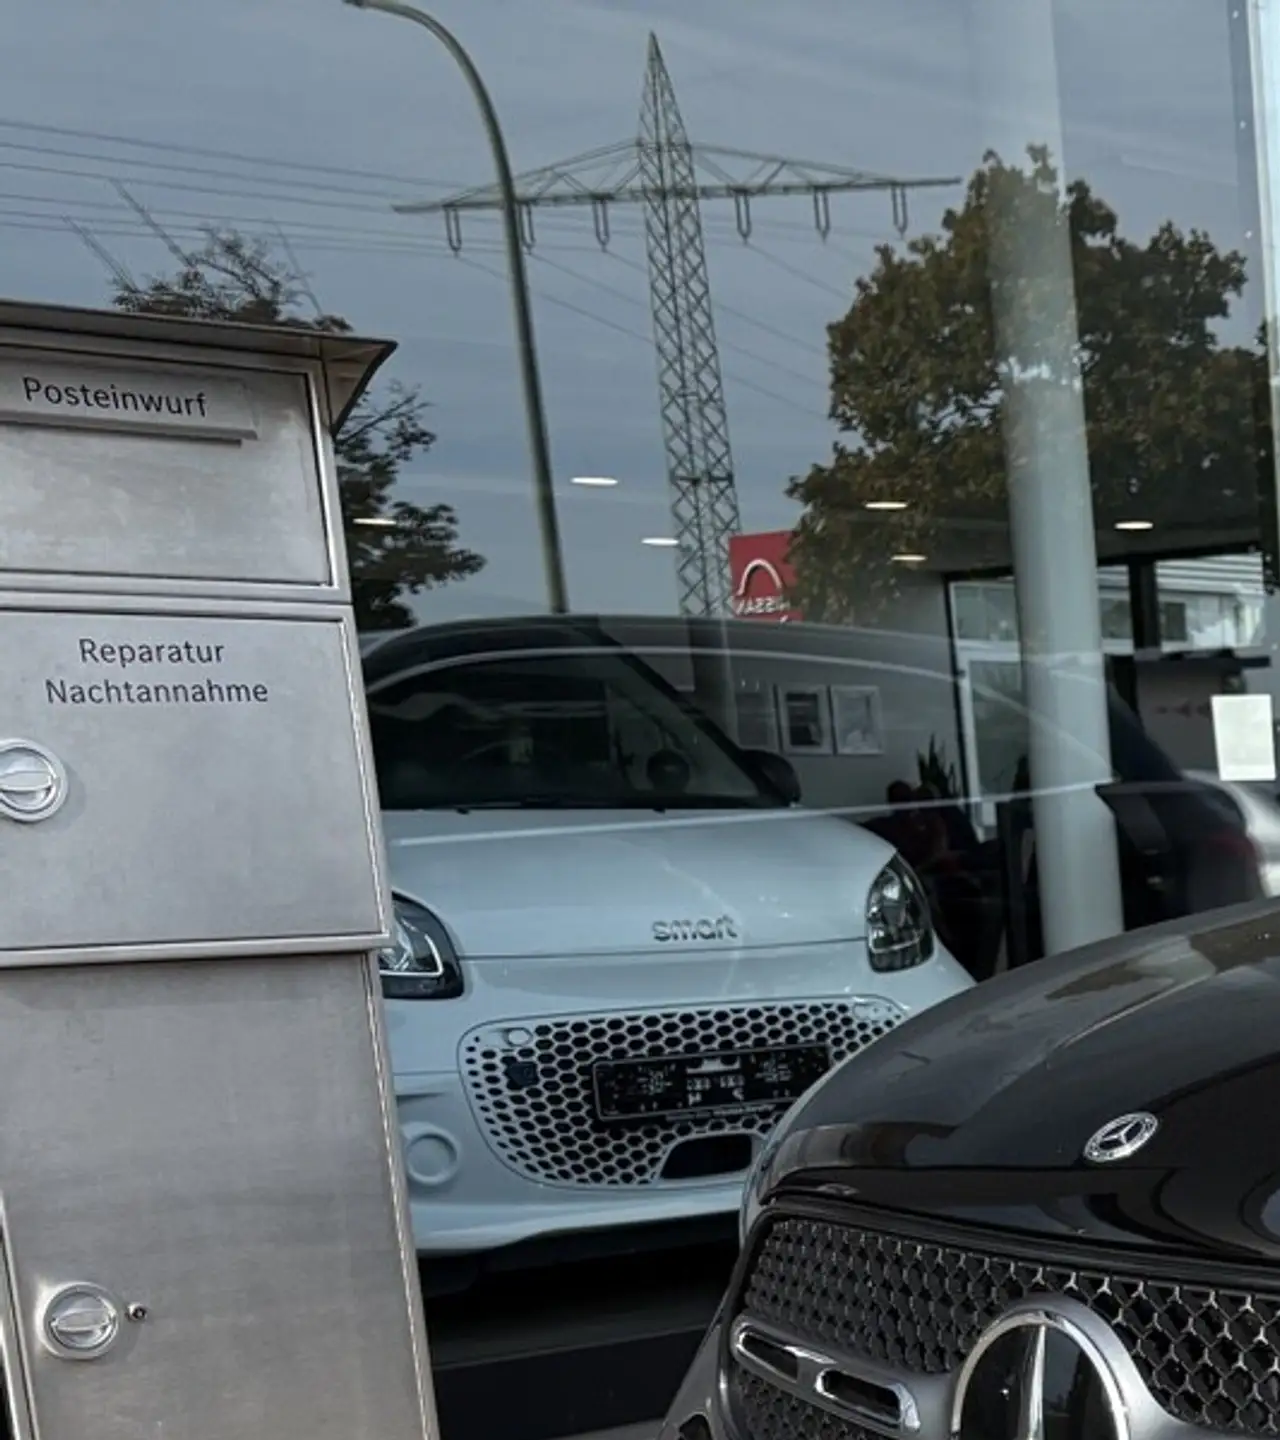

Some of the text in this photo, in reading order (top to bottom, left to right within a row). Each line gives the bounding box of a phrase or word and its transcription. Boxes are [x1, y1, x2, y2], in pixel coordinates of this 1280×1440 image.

[24, 376, 207, 417] Posteinwurf
[79, 638, 224, 668] Reparatur
[45, 679, 268, 704] Nachtannahme
[652, 914, 738, 942] smart
